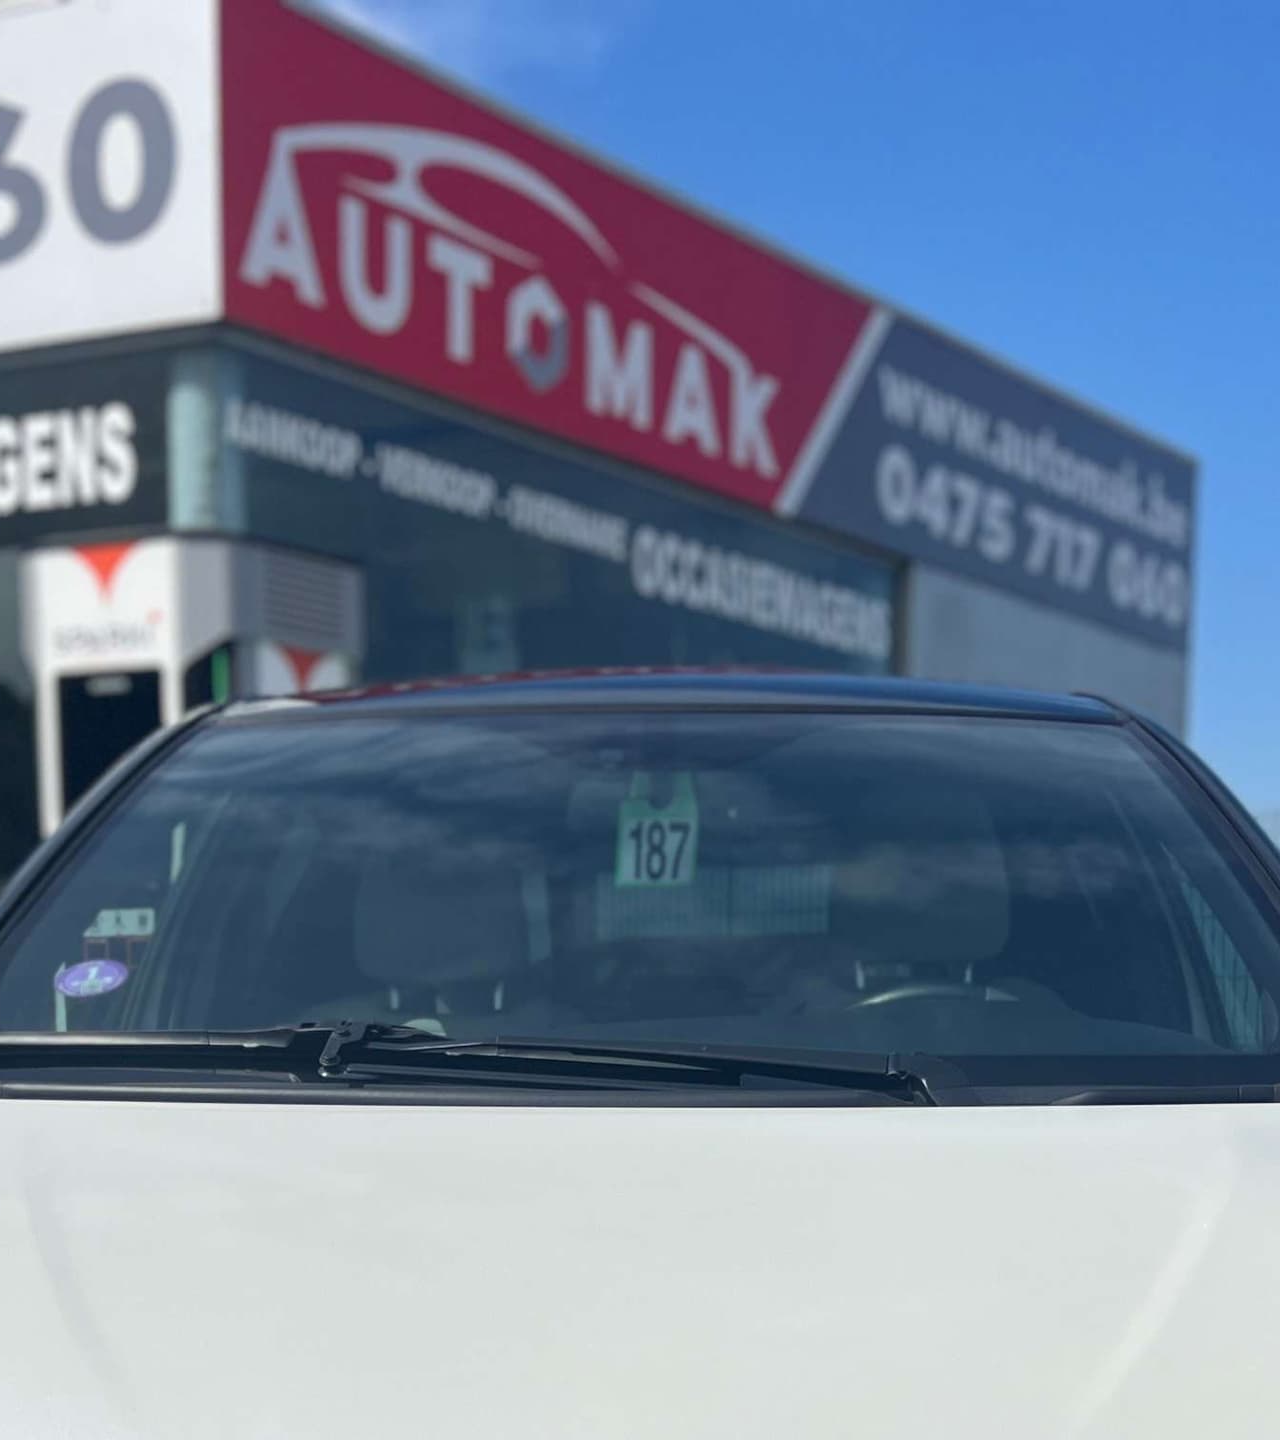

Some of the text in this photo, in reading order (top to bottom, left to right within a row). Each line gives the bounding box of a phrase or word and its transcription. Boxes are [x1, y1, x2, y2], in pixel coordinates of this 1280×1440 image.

[238, 126, 784, 478] AUTOMAK
[875, 443, 1017, 565] 0475
[629, 820, 691, 880] 187
